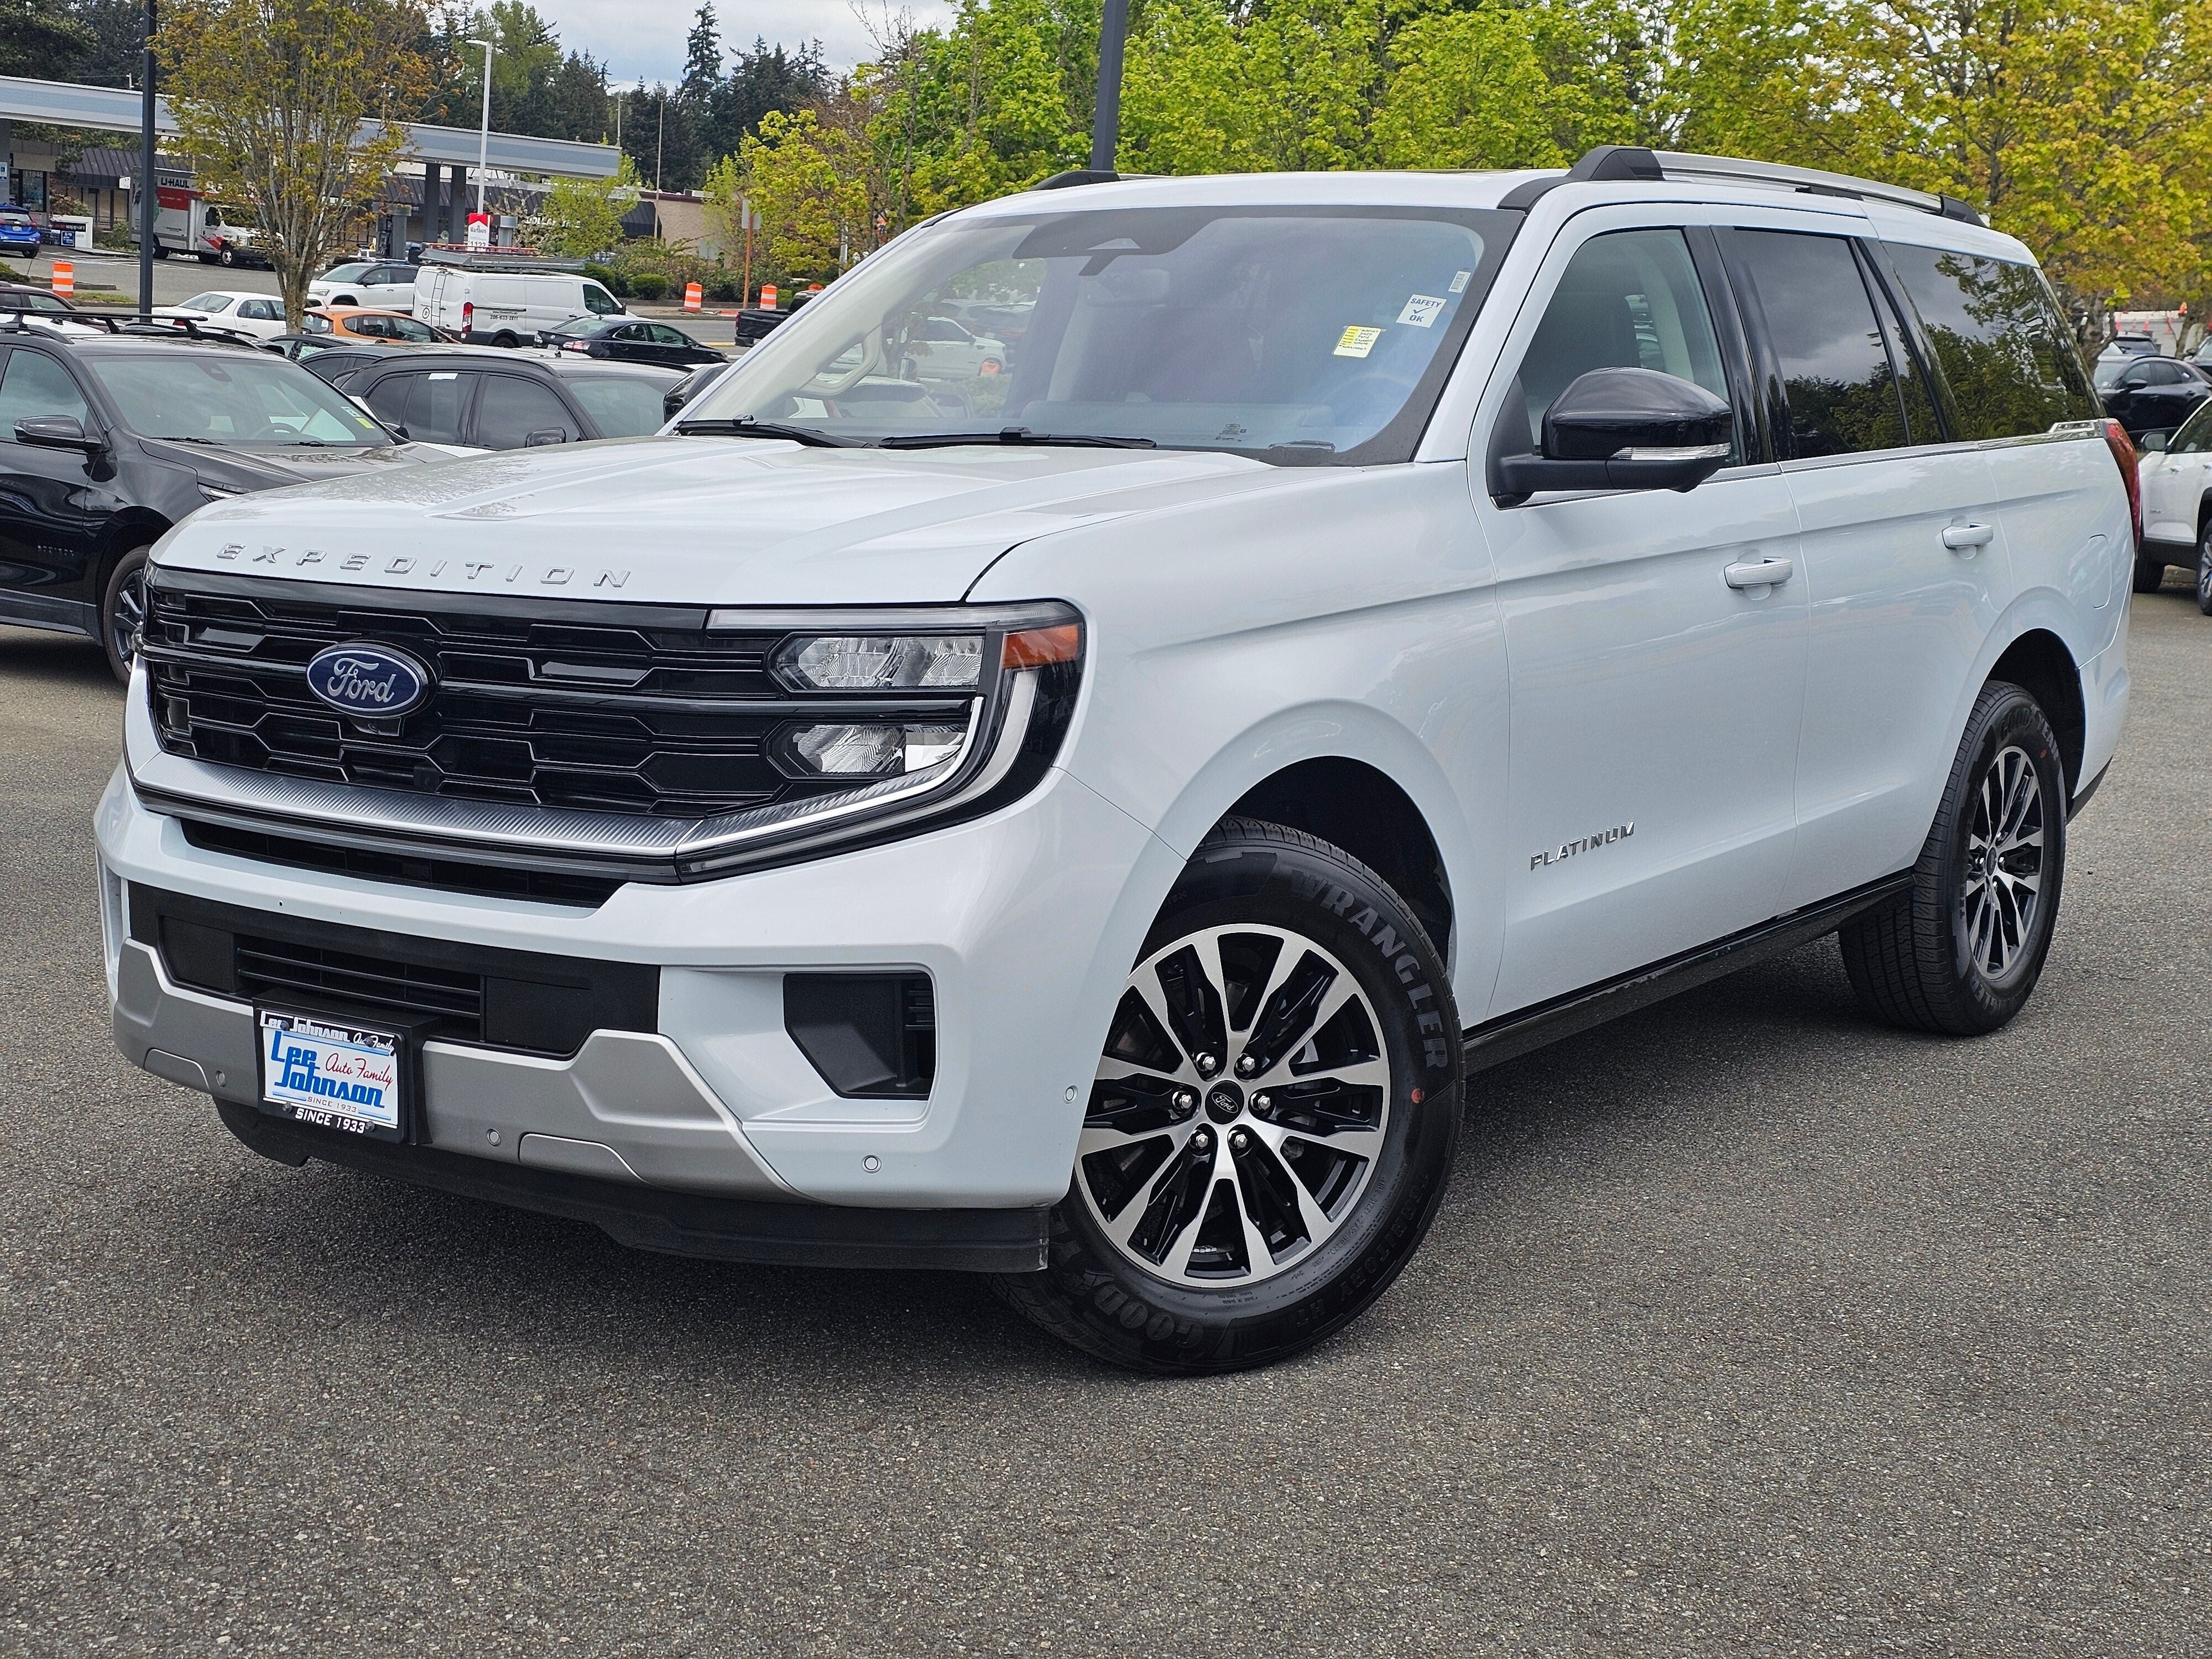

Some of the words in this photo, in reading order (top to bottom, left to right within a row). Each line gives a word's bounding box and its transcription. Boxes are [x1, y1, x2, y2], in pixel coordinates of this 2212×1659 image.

[161, 177, 189, 189] U-HAUL
[1410, 298, 1442, 307] SAFETY
[216, 542, 631, 588] EXPEDITION
[326, 657, 397, 703] Ford
[1530, 821, 1635, 870] PLATINUM
[1289, 869, 1449, 1071] WRANGLER
[271, 1030, 321, 1070] Lee
[290, 1016, 351, 1043] Johnson
[370, 1035, 395, 1057] Family
[274, 1061, 385, 1109] Johnson
[325, 1052, 353, 1076] Auto
[354, 1057, 394, 1092] Family
[295, 1108, 332, 1126] SINCE
[336, 1117, 366, 1134] 1933
[307, 1096, 332, 1107] SINCE
[336, 1103, 357, 1113] 1933
[1215, 1095, 1235, 1111] Ford
